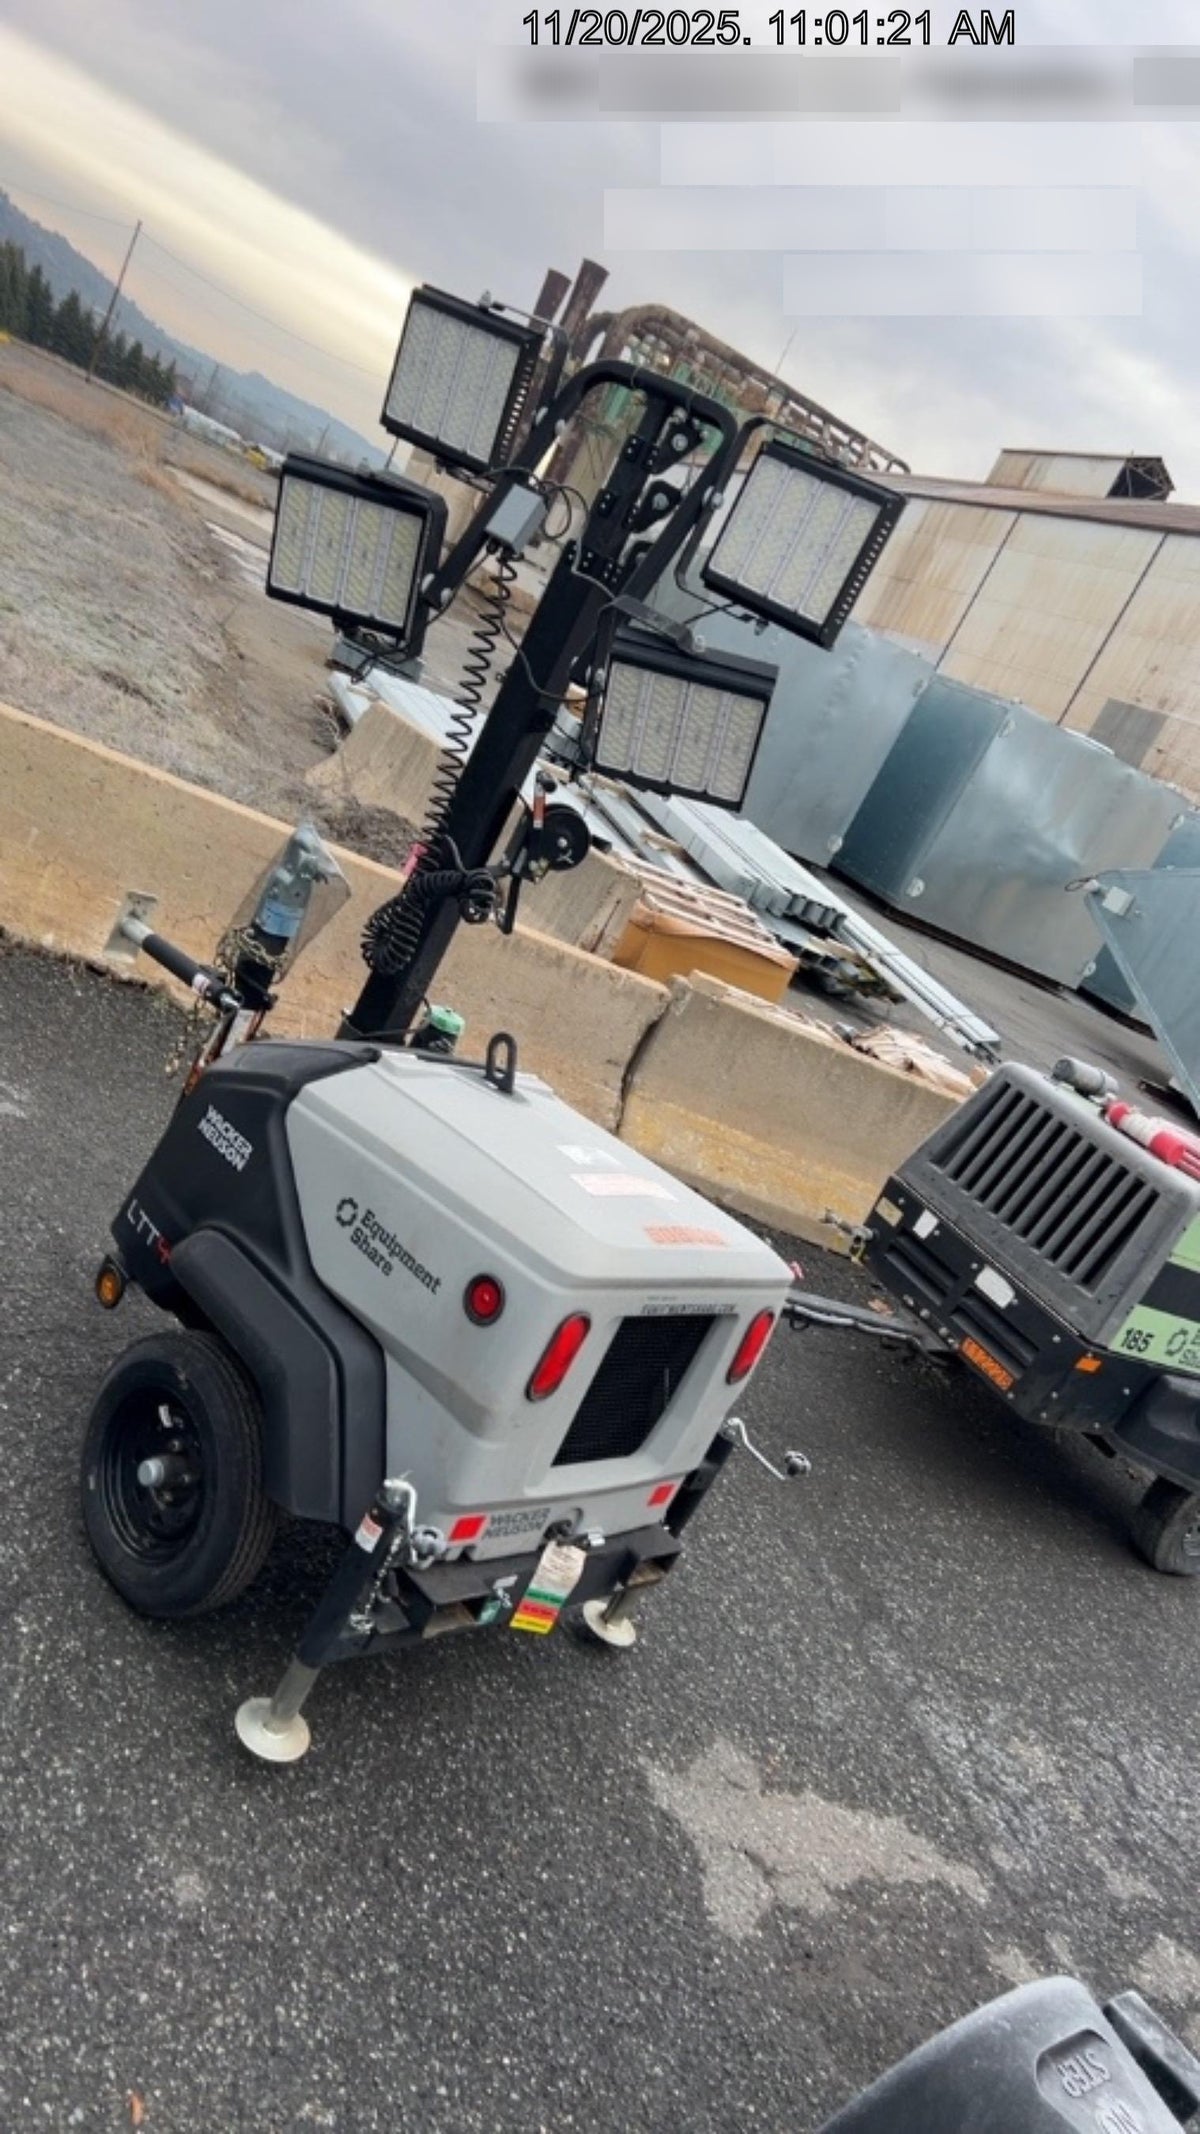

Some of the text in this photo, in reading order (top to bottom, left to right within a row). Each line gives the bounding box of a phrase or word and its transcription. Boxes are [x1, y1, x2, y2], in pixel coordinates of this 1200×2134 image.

[197, 1117, 247, 1172] NEUSON
[206, 1104, 254, 1160] WACKER
[350, 1227, 394, 1276] Share
[361, 1208, 441, 1295] Equipment
[1121, 1328, 1155, 1353] 185
